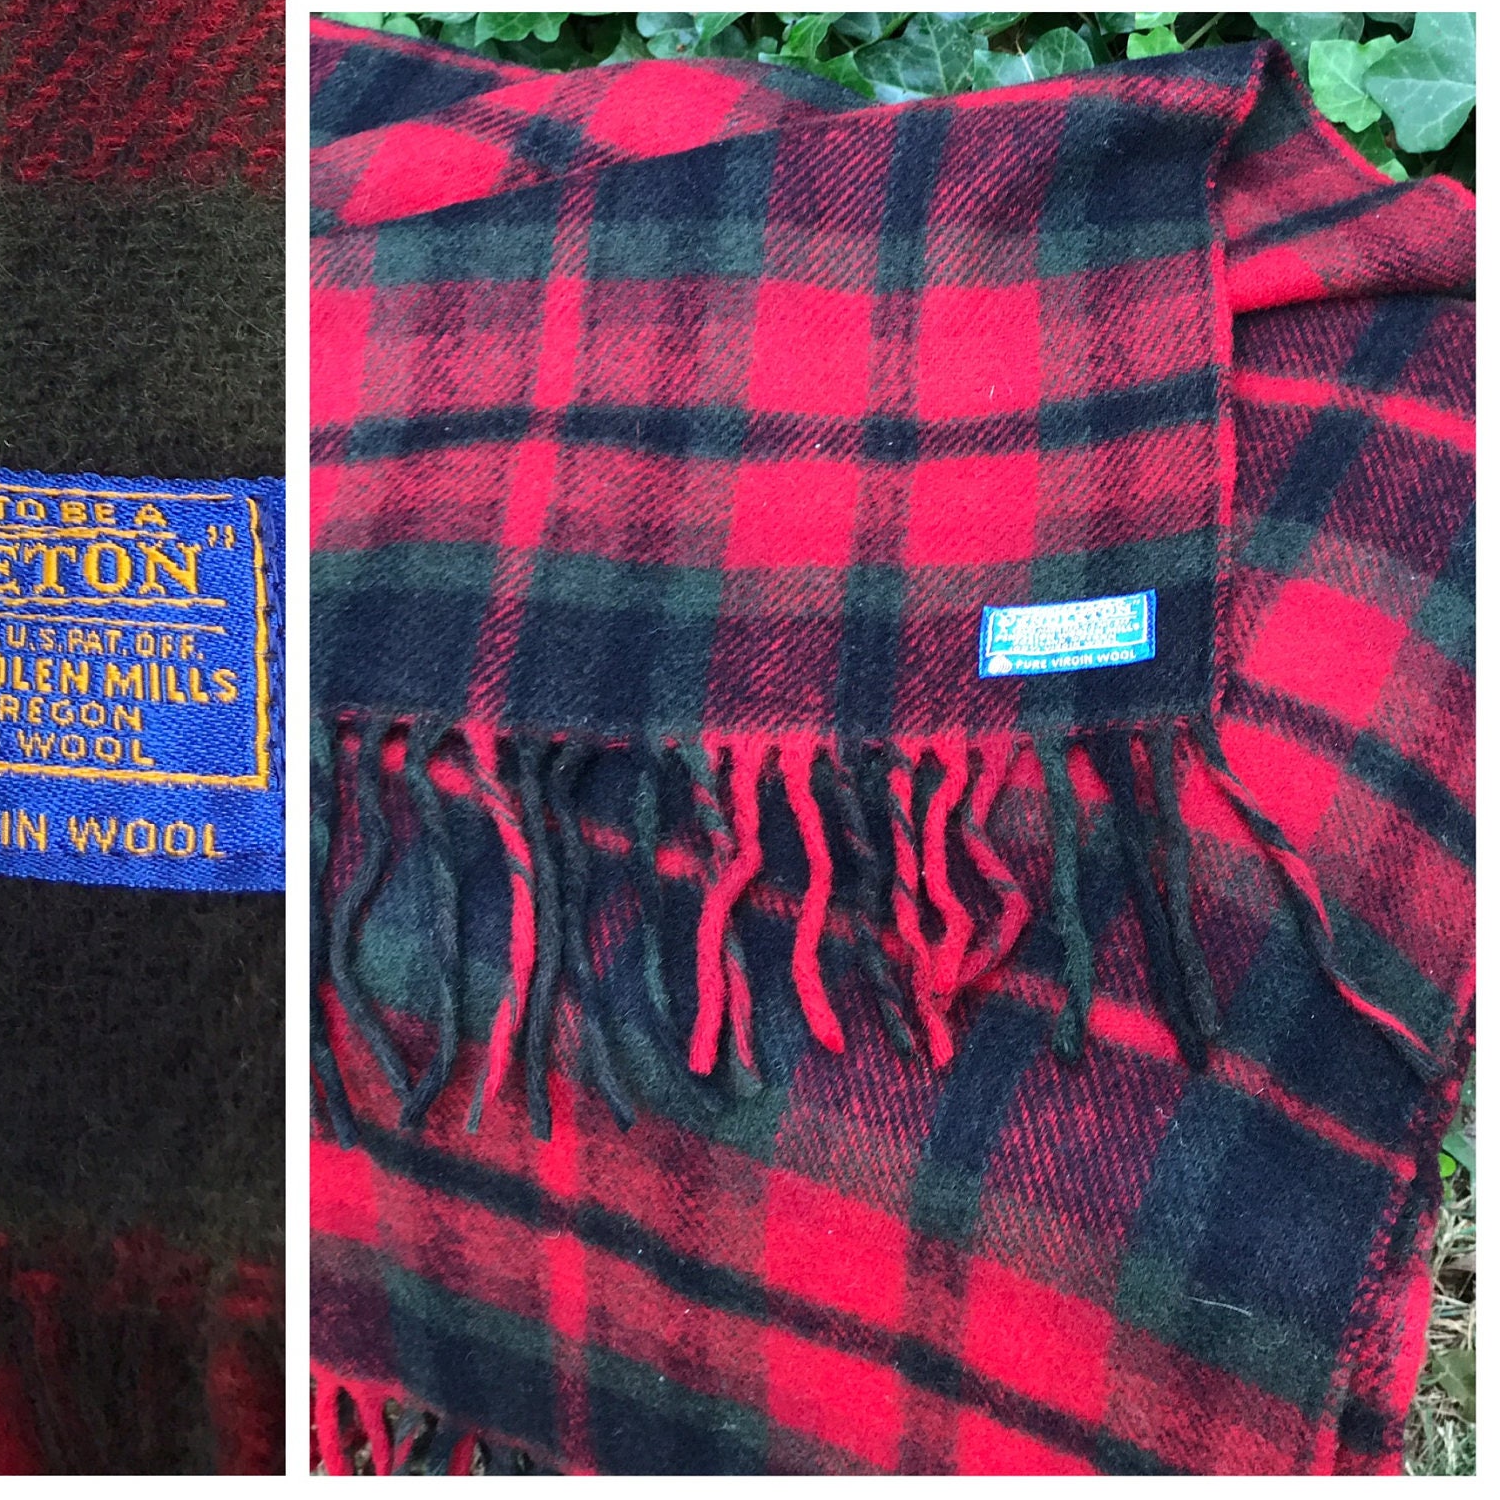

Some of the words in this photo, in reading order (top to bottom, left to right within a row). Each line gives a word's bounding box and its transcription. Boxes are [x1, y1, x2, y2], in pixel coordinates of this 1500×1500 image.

[59, 501, 117, 525] BE
[133, 503, 168, 527] A
[1015, 658, 1047, 670] PURE
[1052, 654, 1093, 668] VIRGIN
[1097, 650, 1136, 663] WOOL
[105, 662, 238, 705] MILLS
[16, 733, 156, 767] WOOL
[68, 816, 225, 858] WOOL
